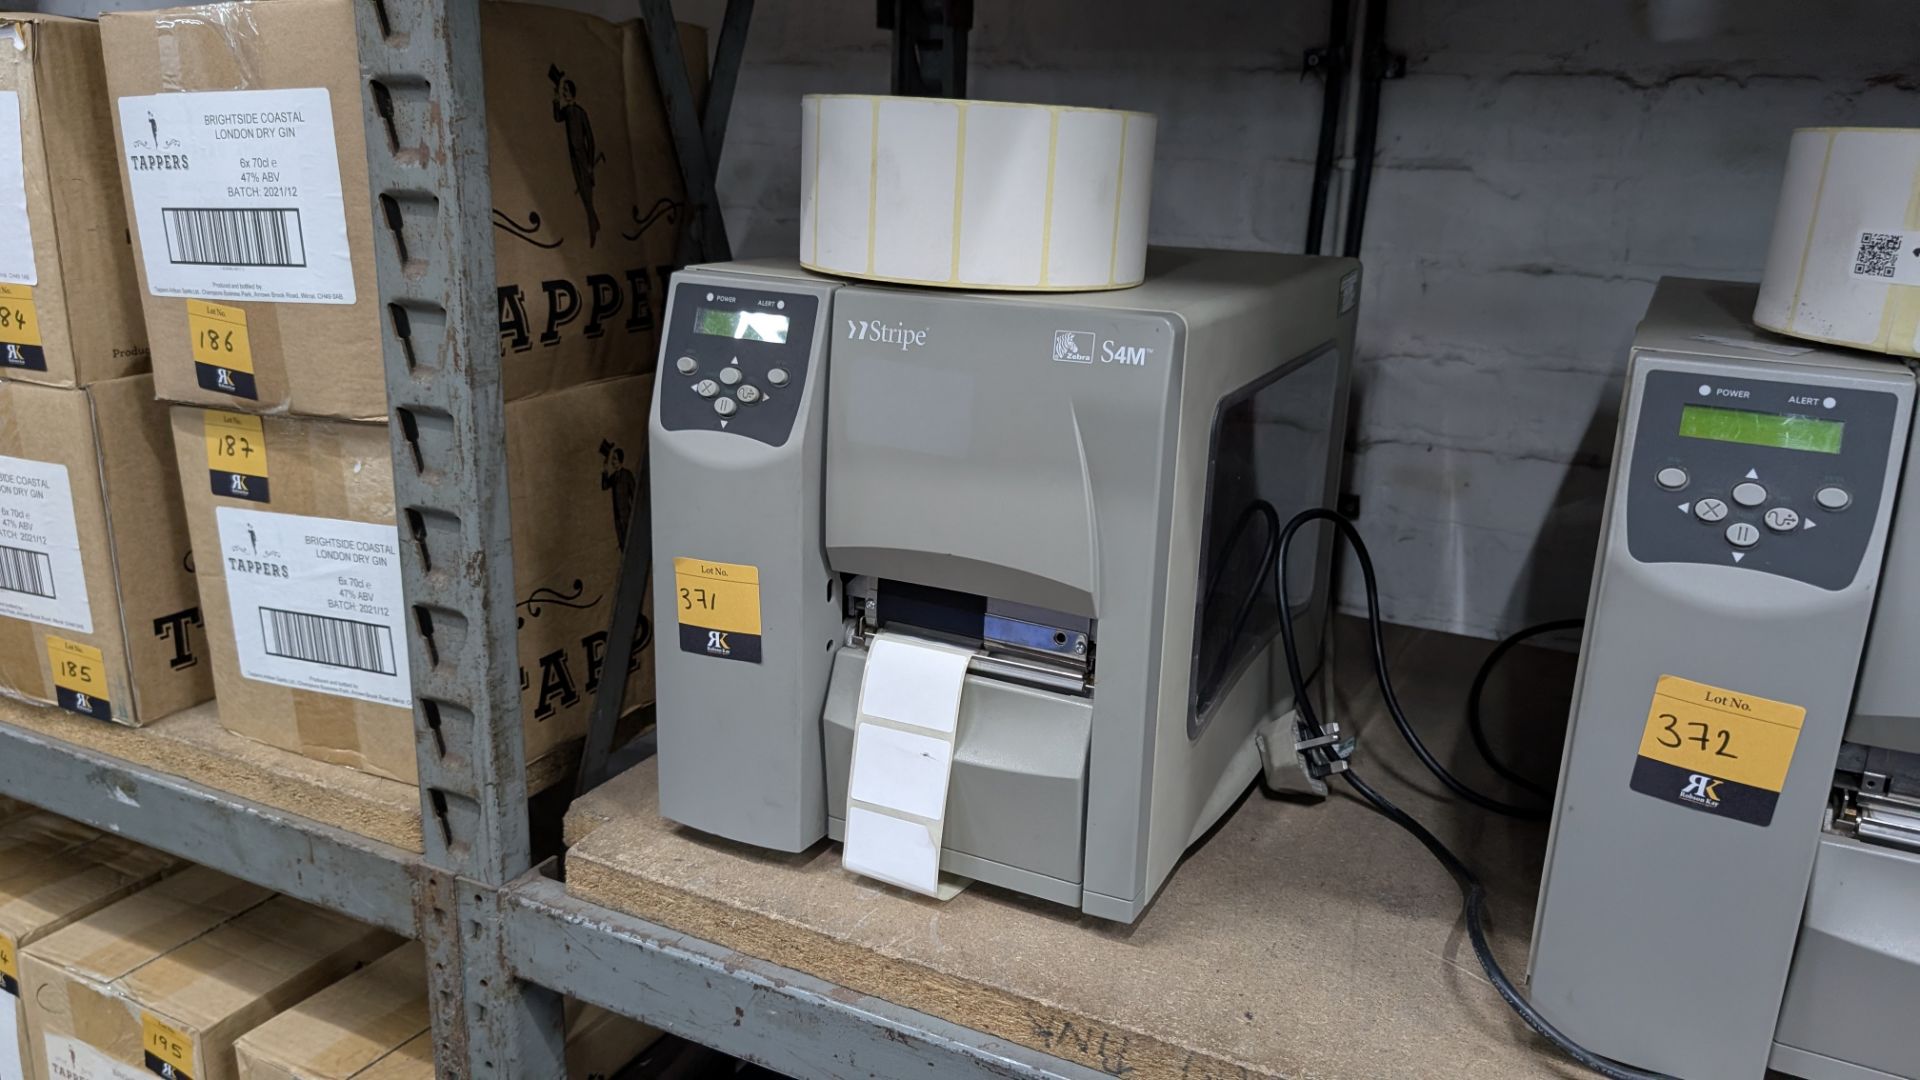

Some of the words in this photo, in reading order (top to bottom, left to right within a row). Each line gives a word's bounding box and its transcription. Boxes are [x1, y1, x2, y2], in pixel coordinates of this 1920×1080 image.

[204, 113, 258, 126] BRIGHTSIDE
[261, 112, 305, 124] COASTAL
[215, 129, 254, 140] LONDON
[256, 128, 275, 139] DRY
[278, 127, 295, 138] GIN
[131, 154, 189, 171] TAPPERS
[240, 157, 250, 168] 6x
[252, 157, 269, 168] 70cl
[241, 173, 259, 183] 47%
[261, 172, 280, 182] ABV
[228, 187, 261, 197] BATCH:
[263, 187, 298, 197] 2021/12
[717, 295, 736, 303] POWER
[757, 299, 776, 307] ALERT
[201, 329, 233, 352] 186
[869, 320, 926, 351] Stripe
[1067, 352, 1091, 361] Zebra
[1716, 388, 1750, 398] POWER
[1788, 395, 1820, 406] ALERT
[219, 435, 254, 458] 187
[16, 475, 50, 489] COASTAL
[13, 486, 28, 497] DRY
[30, 488, 44, 499] GIN
[19, 521, 33, 531] ABV
[305, 535, 355, 551] BRIGHTSIDE
[357, 541, 396, 555] COASTAL
[316, 550, 352, 562] LONDON
[353, 553, 370, 565] DRY
[372, 555, 388, 567] GIN
[228, 557, 289, 579] TAPPERS
[701, 565, 714, 575] Lot
[715, 567, 728, 577] No.
[339, 589, 356, 600] 47%
[358, 590, 374, 602] ABV
[680, 587, 716, 610] 371
[359, 604, 390, 617] 2021/12
[153, 606, 205, 672] T
[61, 661, 92, 683] 185
[1704, 690, 1727, 705] Lot
[1729, 697, 1752, 712] No.
[1656, 713, 1738, 759] 372
[153, 1032, 183, 1059] 195
